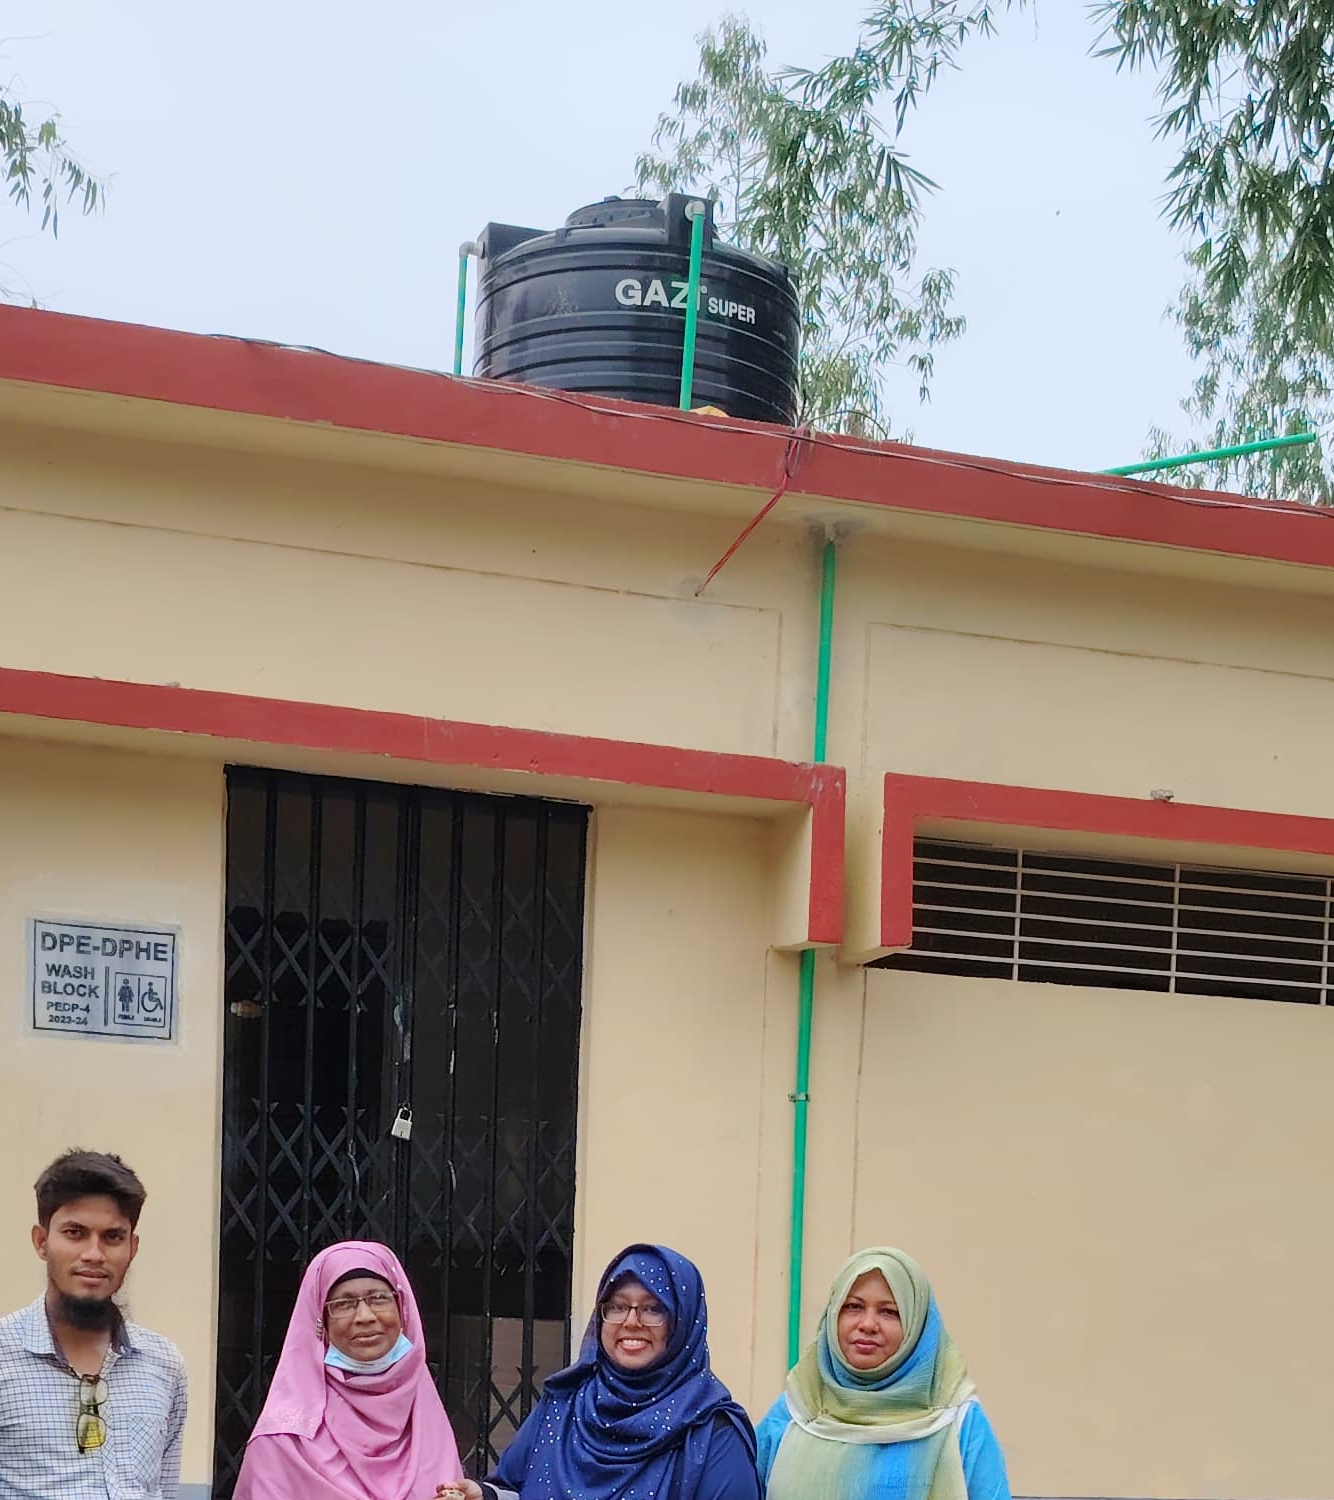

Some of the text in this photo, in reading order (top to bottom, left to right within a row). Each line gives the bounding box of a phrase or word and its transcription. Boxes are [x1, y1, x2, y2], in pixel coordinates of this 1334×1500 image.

[708, 296, 756, 324] SUPER
[41, 931, 168, 962] DPE-DPHE
[45, 963, 95, 980] WASH
[41, 980, 100, 998] BLOCK
